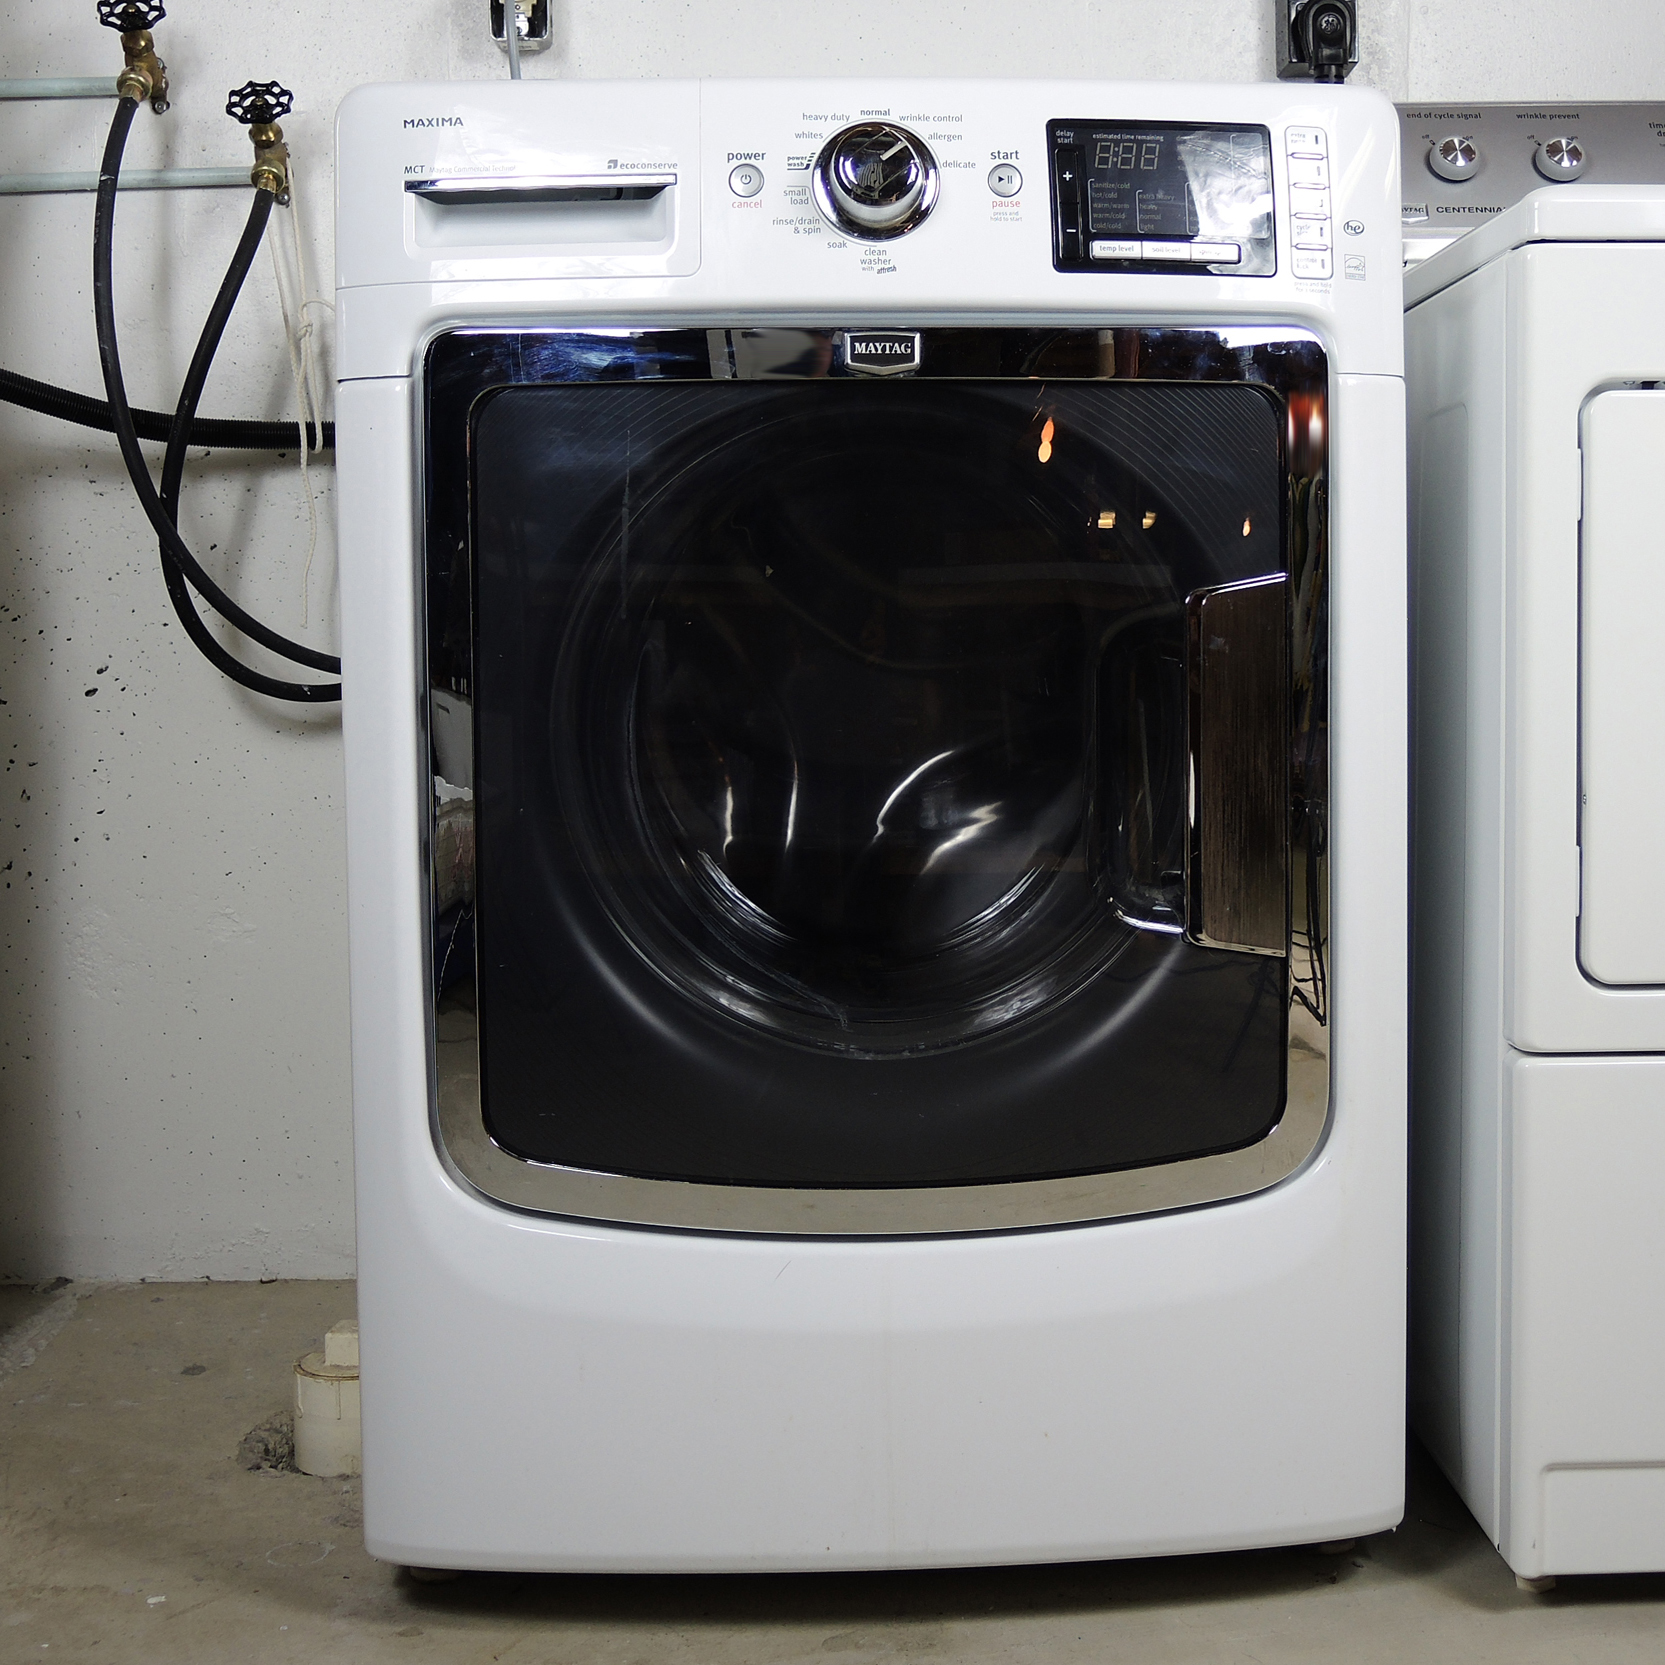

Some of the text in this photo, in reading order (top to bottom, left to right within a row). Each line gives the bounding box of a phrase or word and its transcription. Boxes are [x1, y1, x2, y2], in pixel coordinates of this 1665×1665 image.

[802, 112, 850, 122] heavy duty
[860, 108, 891, 117] normal
[1434, 112, 1455, 120] cycle
[1456, 112, 1482, 121] signal
[1516, 112, 1580, 121] wrinkle prevent
[403, 116, 464, 129] MAXIMA
[898, 113, 963, 123] wrinkle control
[794, 131, 824, 139] whites
[927, 132, 963, 142] allergen
[1055, 130, 1075, 138] delay
[1135, 134, 1164, 142] remaining
[727, 152, 767, 164] power
[990, 150, 1020, 160] start
[403, 164, 426, 174] MCT
[453, 165, 491, 173] Commercial
[619, 162, 678, 170] ecoconserve
[942, 160, 977, 169] delicate
[783, 188, 807, 197] small
[1092, 191, 1118, 199] hot/cold
[731, 199, 763, 209] cancel
[790, 196, 809, 205] load
[992, 200, 1021, 210] pause
[1139, 203, 1158, 212] heavy
[1436, 206, 1506, 214] CENTENNIA
[1092, 212, 1126, 220] warm/cold
[772, 216, 821, 226] rinse/drain
[793, 225, 822, 236] & spin
[1139, 222, 1155, 231] light
[826, 240, 848, 249] soak
[1099, 244, 1135, 253] temp level
[863, 247, 887, 256] clean
[859, 256, 892, 266] washer
[853, 342, 912, 354] MAYTAG
